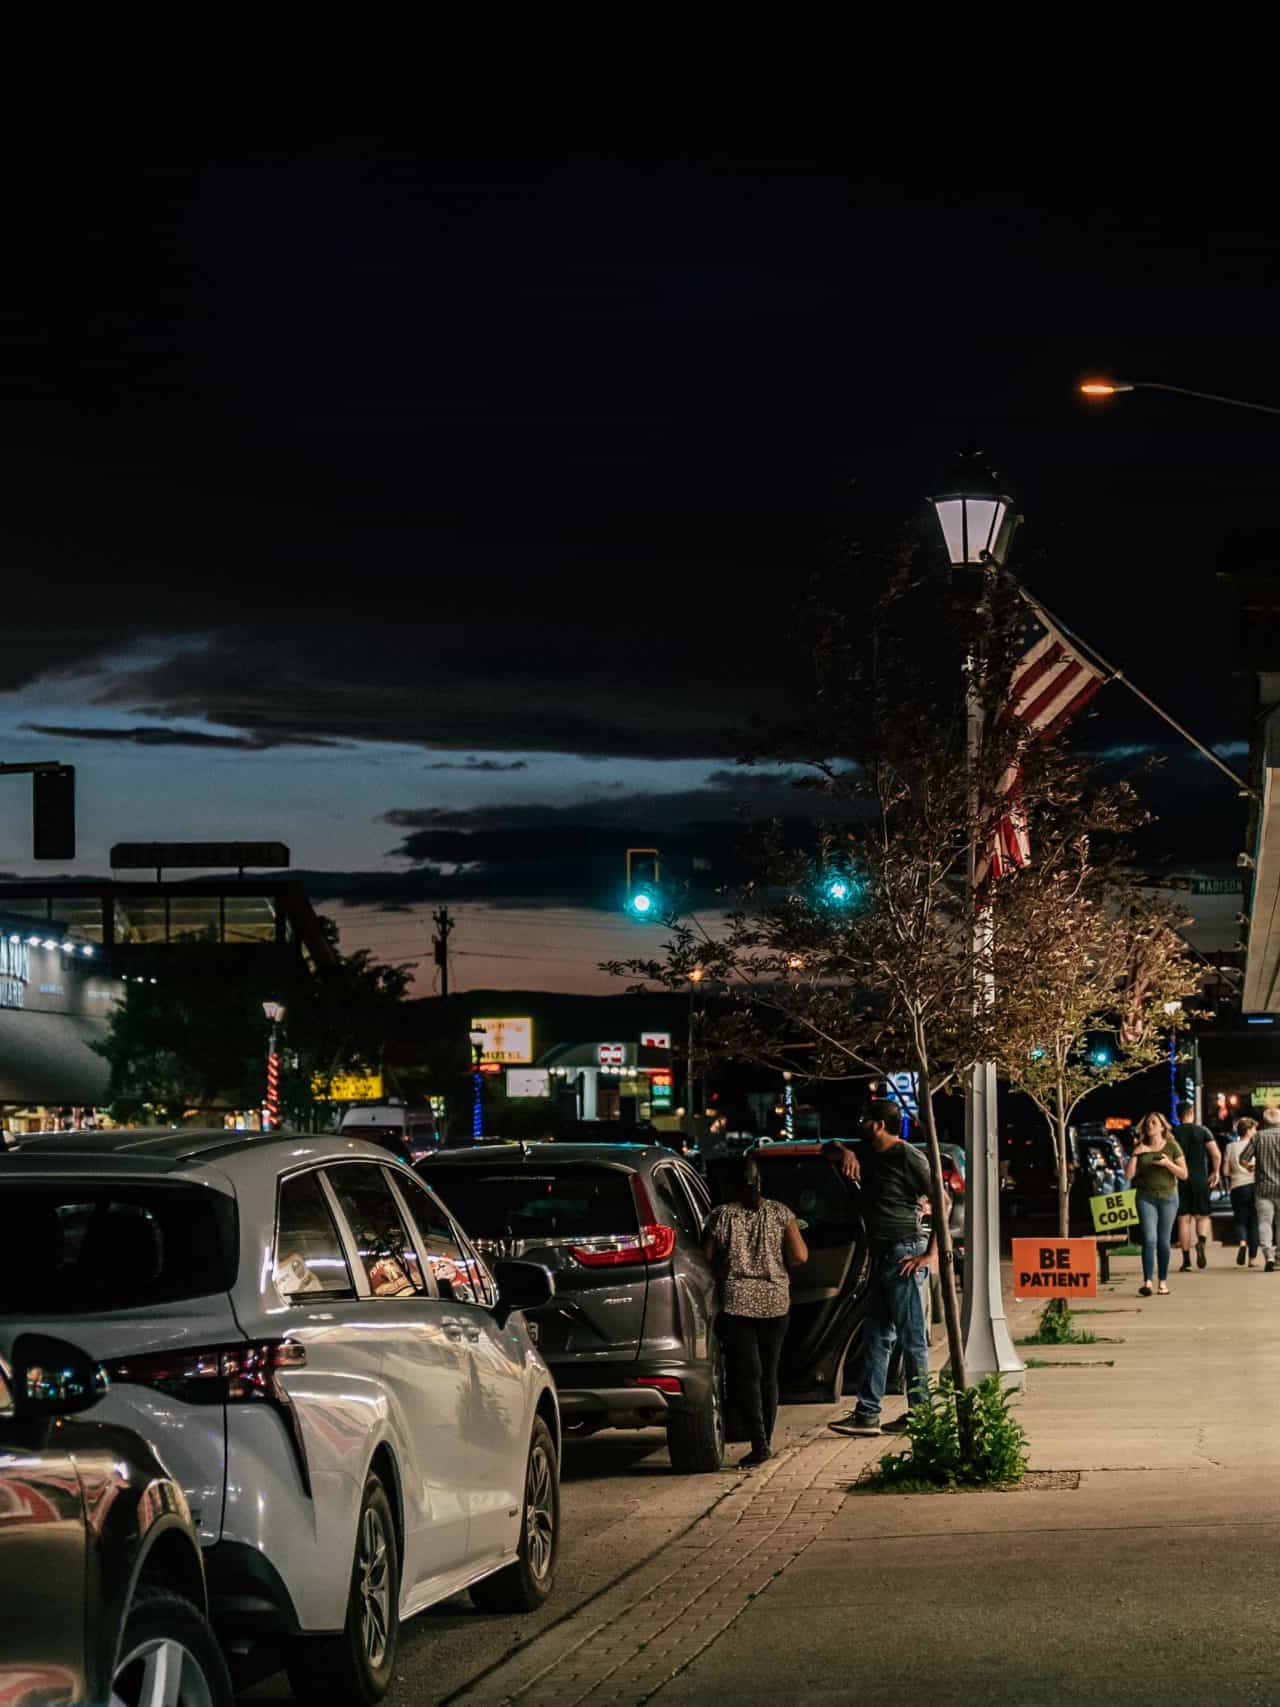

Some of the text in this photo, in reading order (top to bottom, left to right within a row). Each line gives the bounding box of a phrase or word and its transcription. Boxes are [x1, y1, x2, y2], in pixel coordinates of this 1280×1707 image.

[1200, 880, 1243, 892] MADISON
[1105, 1195, 1124, 1209] BE
[1099, 1208, 1137, 1225] COOL
[1039, 1248, 1071, 1269] BE
[1020, 1272, 1091, 1288] PATIENT
